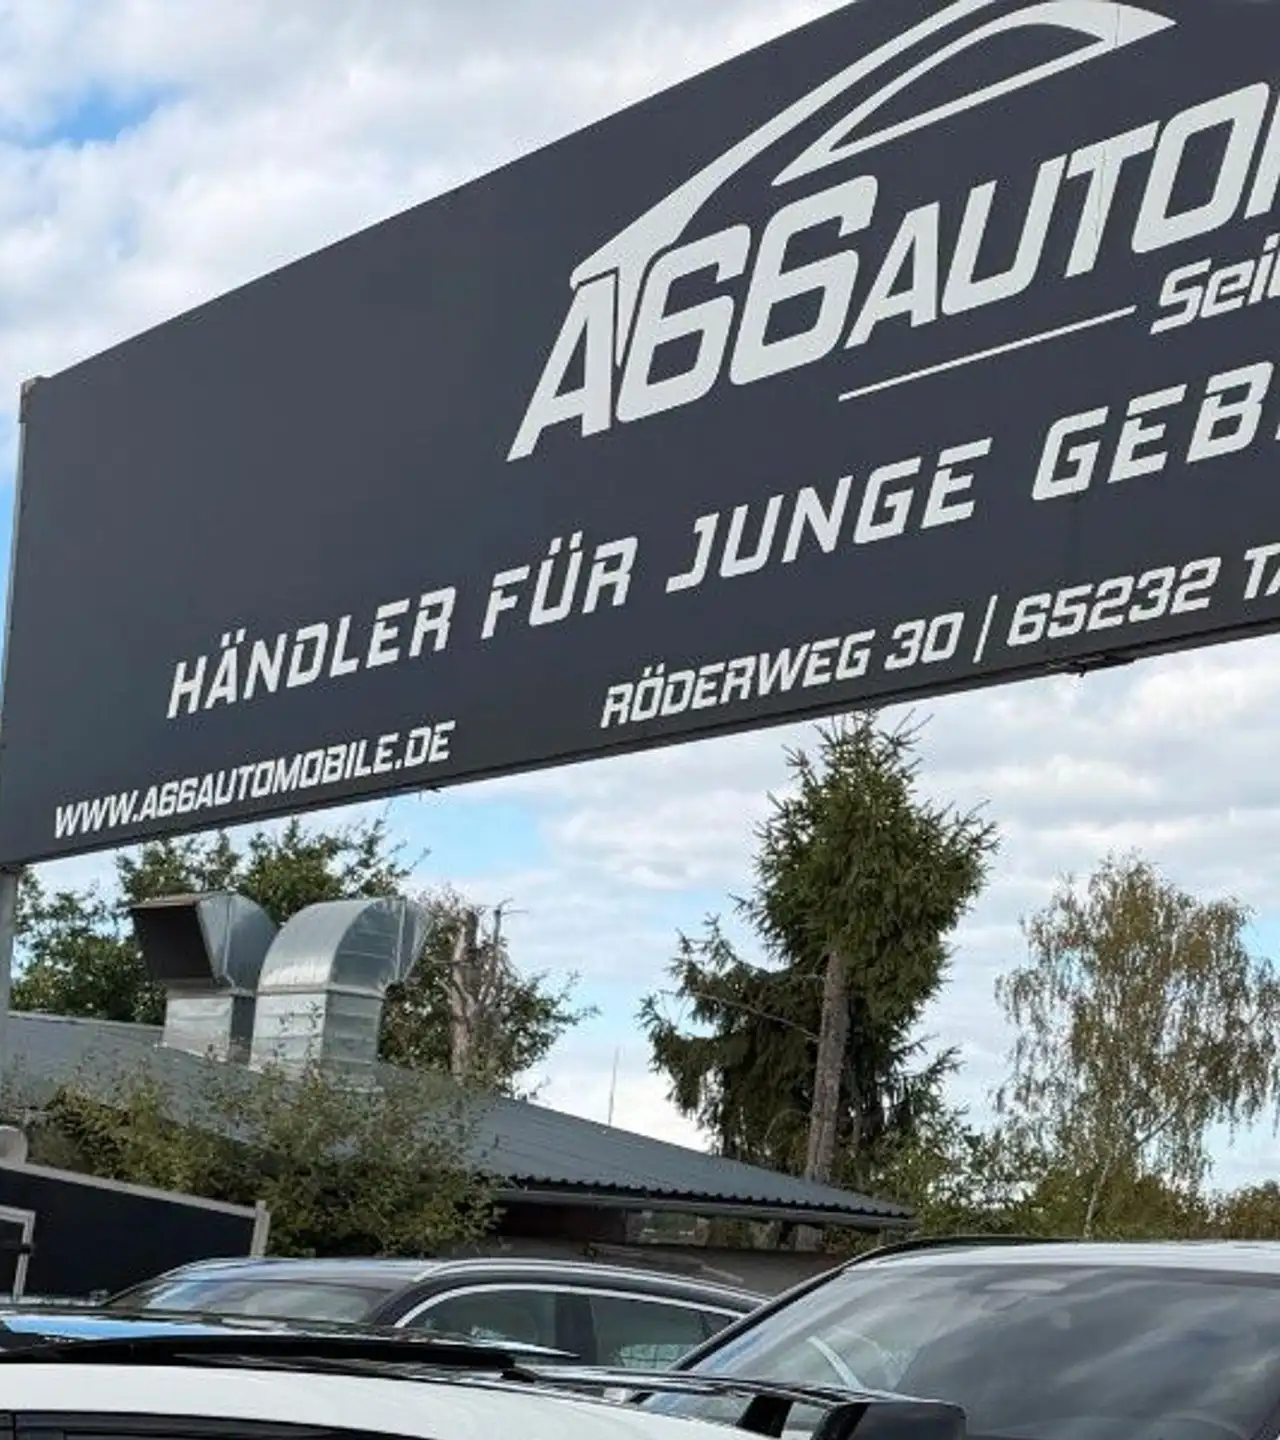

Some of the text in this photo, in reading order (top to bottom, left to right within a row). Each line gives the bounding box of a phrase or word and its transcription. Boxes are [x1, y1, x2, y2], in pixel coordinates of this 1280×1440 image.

[507, 82, 1280, 461] A66AUTO
[167, 362, 1280, 718] HÄNDLER FÜR JUNGE GEB
[601, 629, 875, 728] RÖDERWEG
[885, 612, 964, 670] 30
[1007, 557, 1221, 646] 65232
[55, 721, 455, 839] WWW.A66AUTOMOBILE.DE
